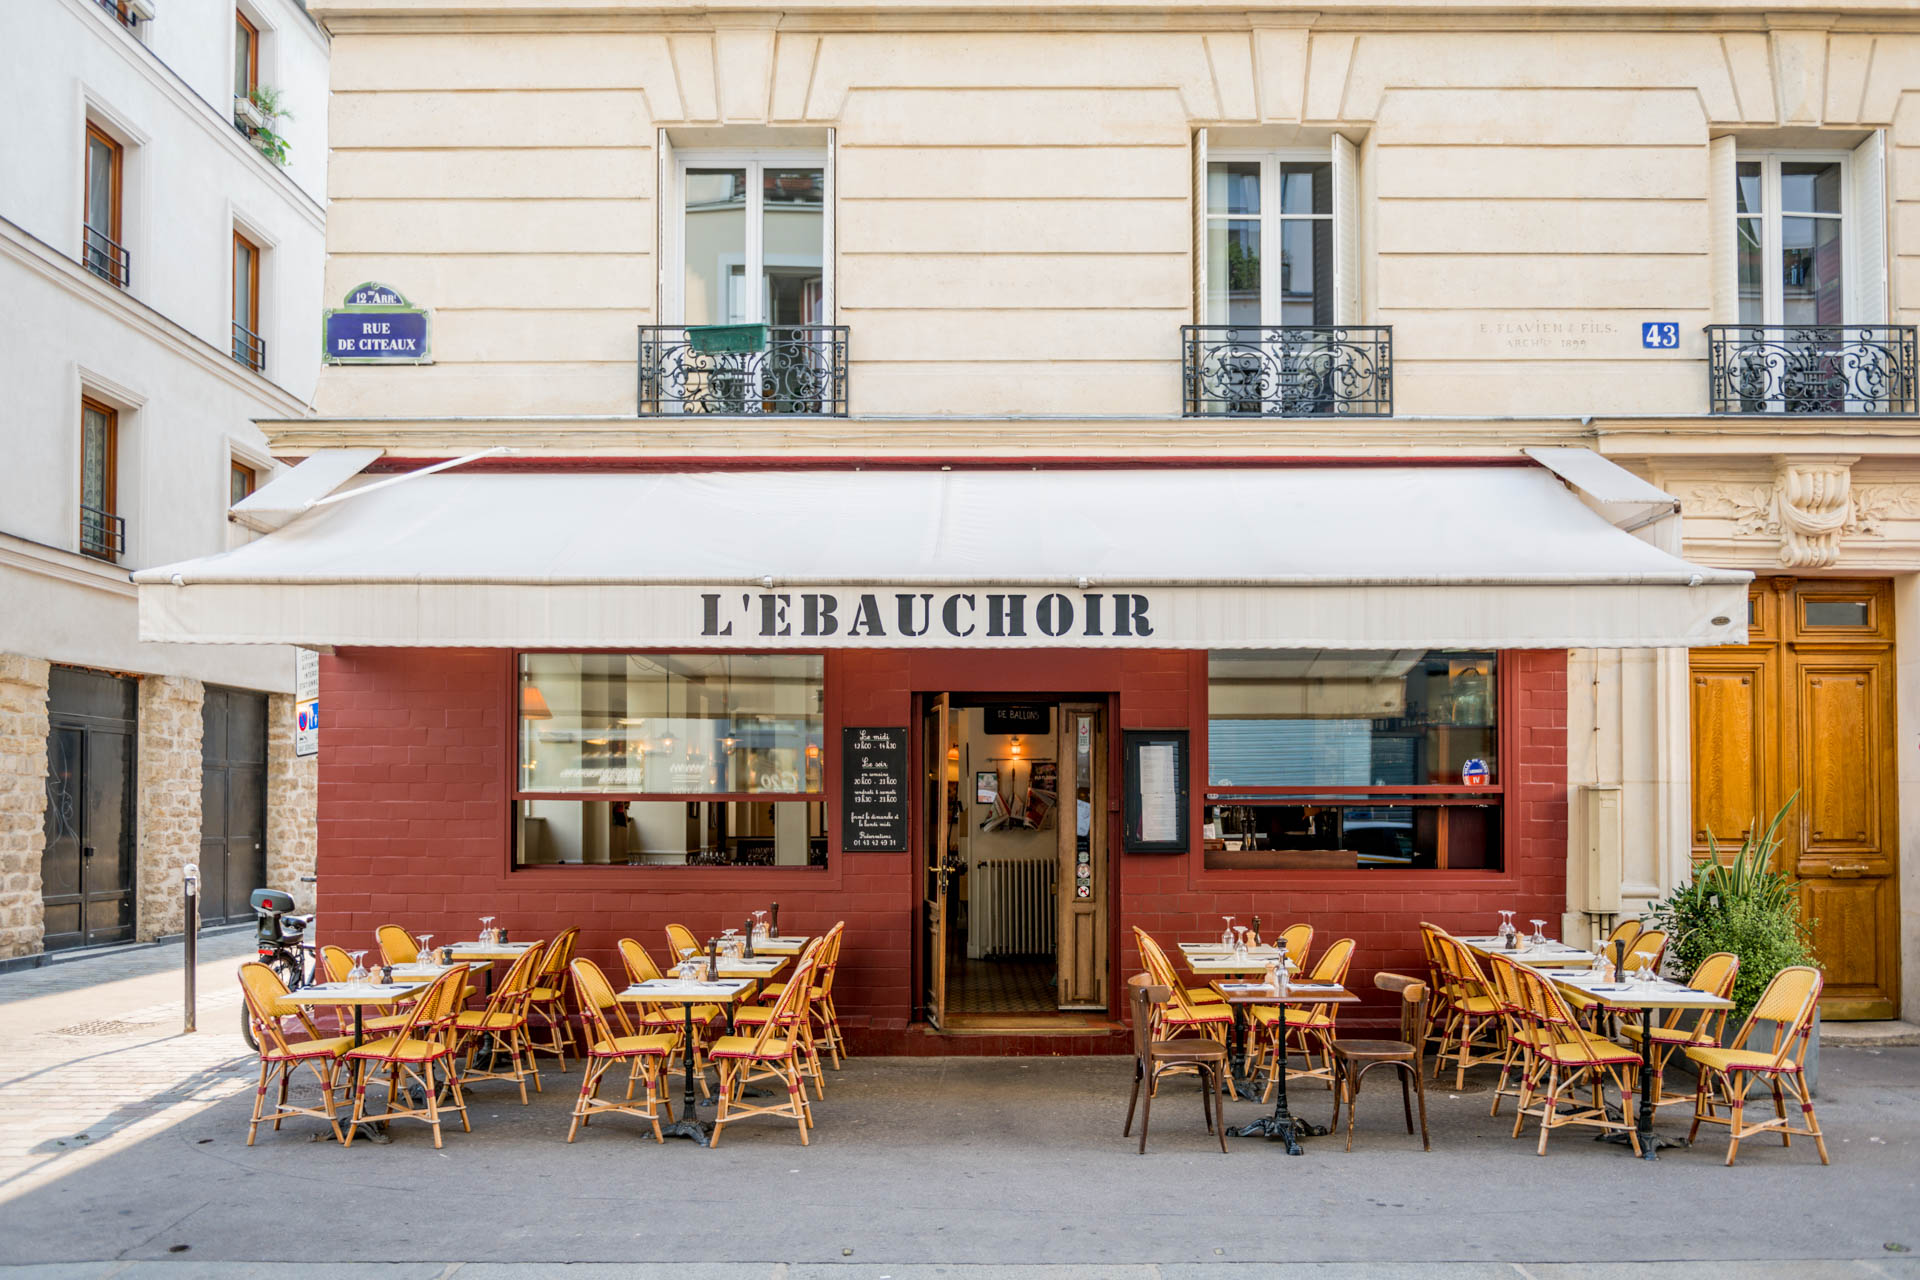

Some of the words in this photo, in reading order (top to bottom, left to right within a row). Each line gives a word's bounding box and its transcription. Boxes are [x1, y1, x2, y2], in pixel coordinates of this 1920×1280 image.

[362, 322, 390, 334] RUE
[1645, 324, 1678, 348] 43
[338, 339, 356, 351] DE
[358, 338, 416, 351] CITEAUX
[700, 593, 1154, 637] L'EBAUCHOIR
[860, 730, 870, 740] Le
[862, 757, 872, 768] Le
